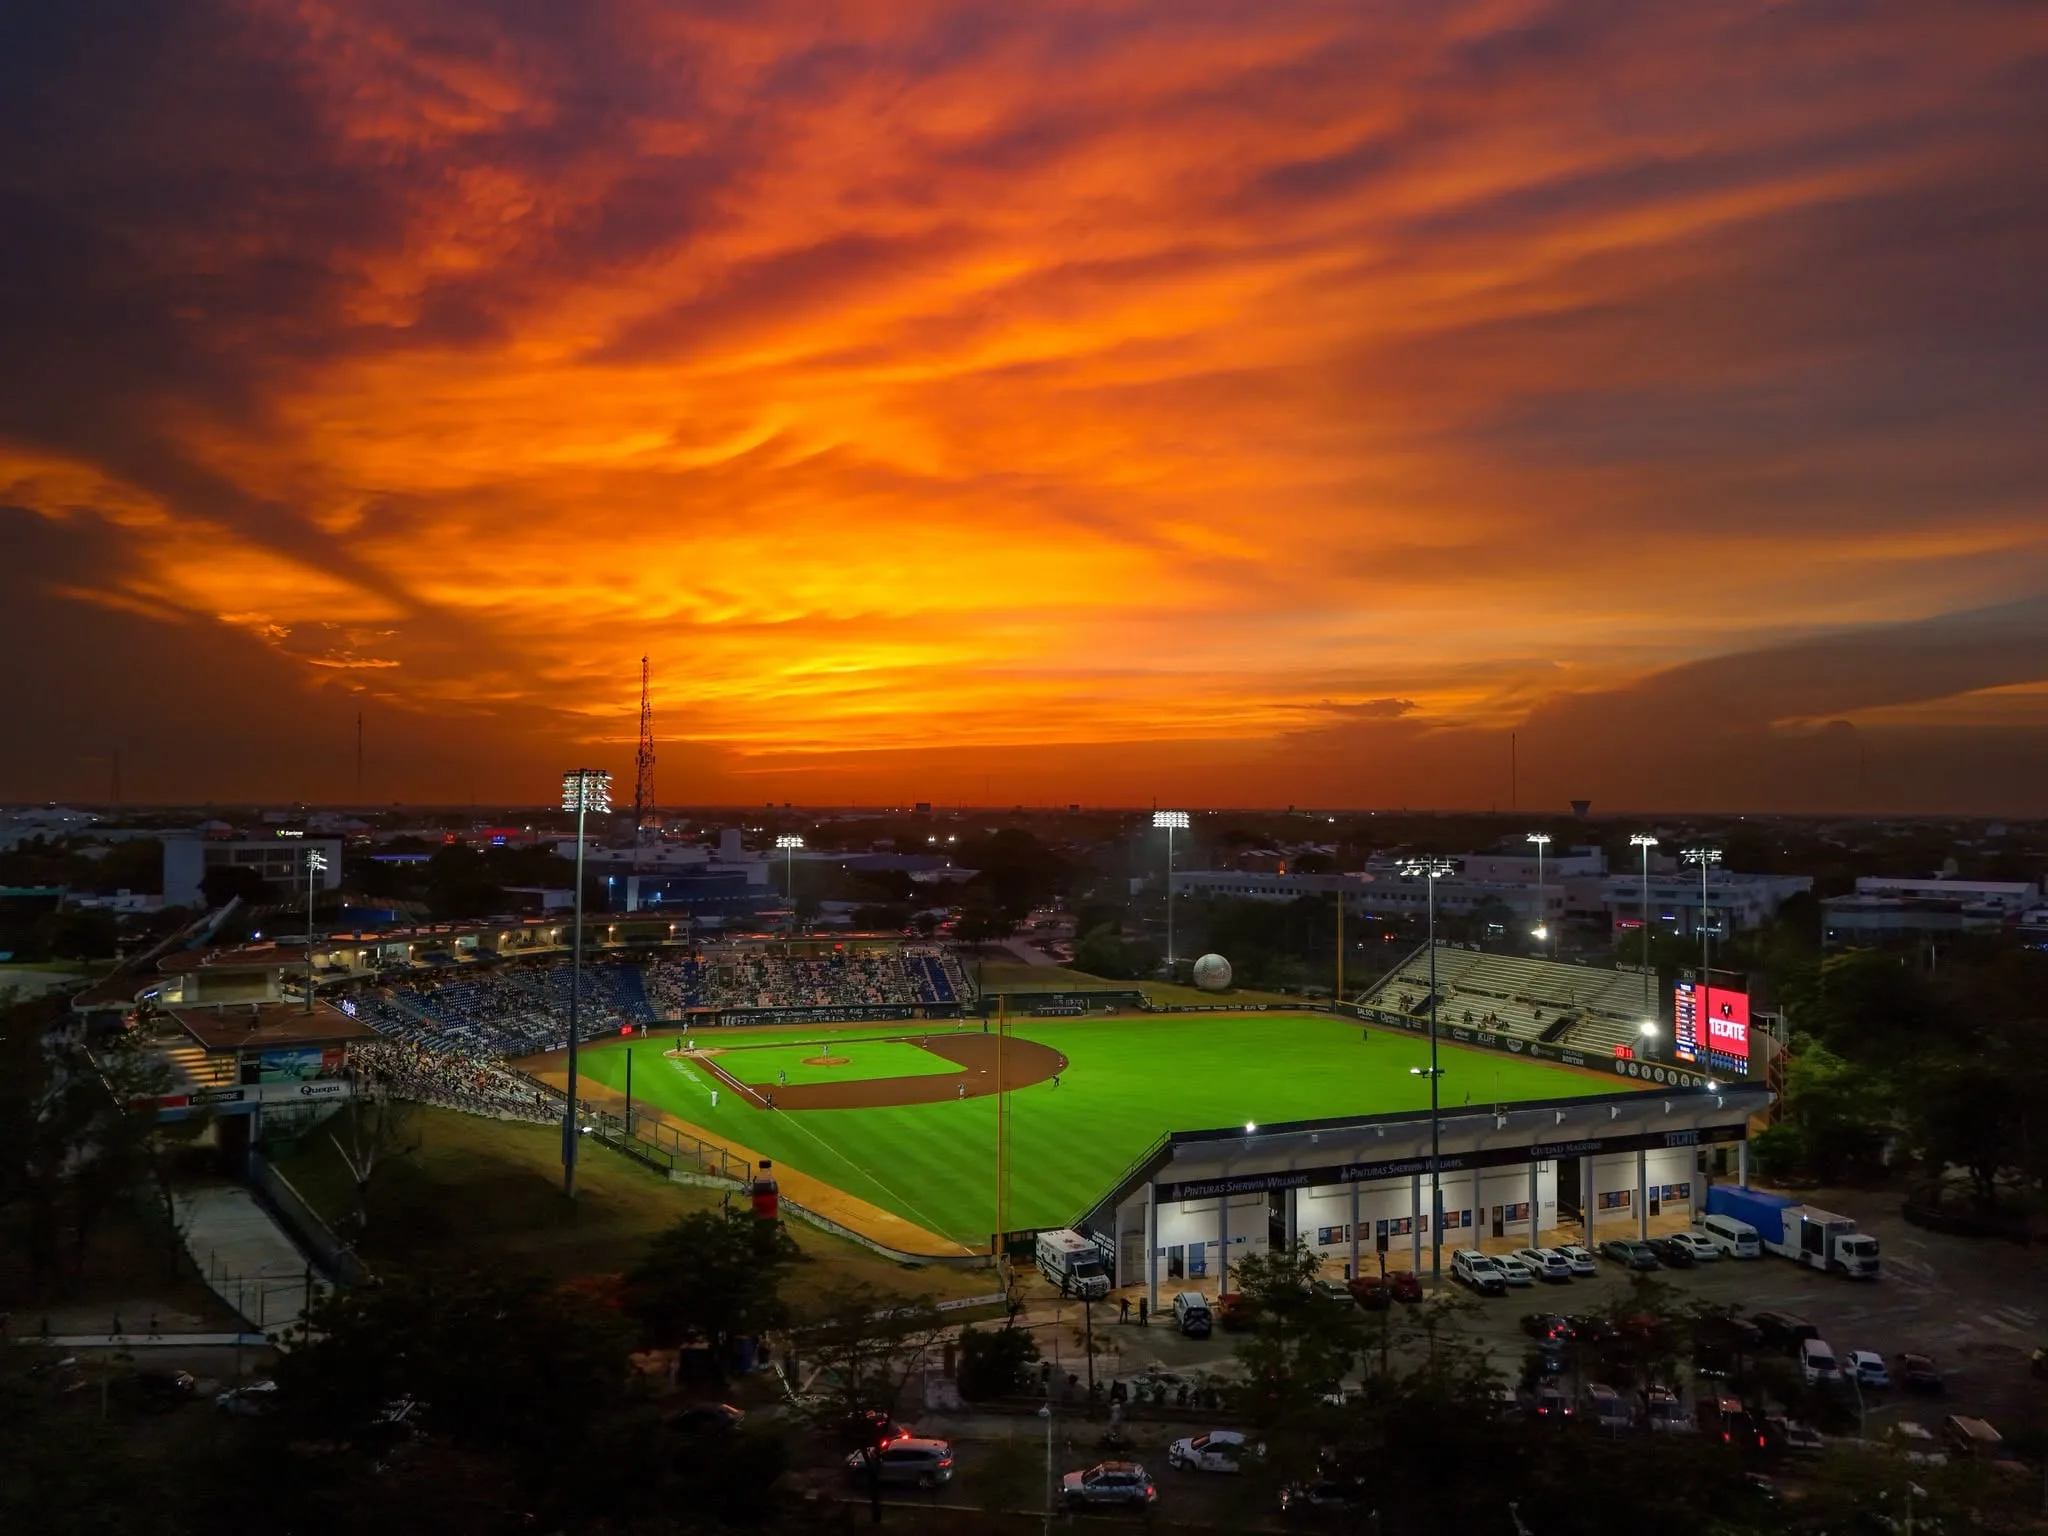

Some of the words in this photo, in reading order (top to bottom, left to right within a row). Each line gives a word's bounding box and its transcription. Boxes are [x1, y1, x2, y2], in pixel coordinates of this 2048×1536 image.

[1708, 1018, 1746, 1041] TECATE
[1664, 1130, 1699, 1147] TECATE
[1349, 1166, 1387, 1179] PINTURAS
[1183, 1184, 1225, 1197] PINTURAS
[1226, 1179, 1264, 1193] SHERWIN
